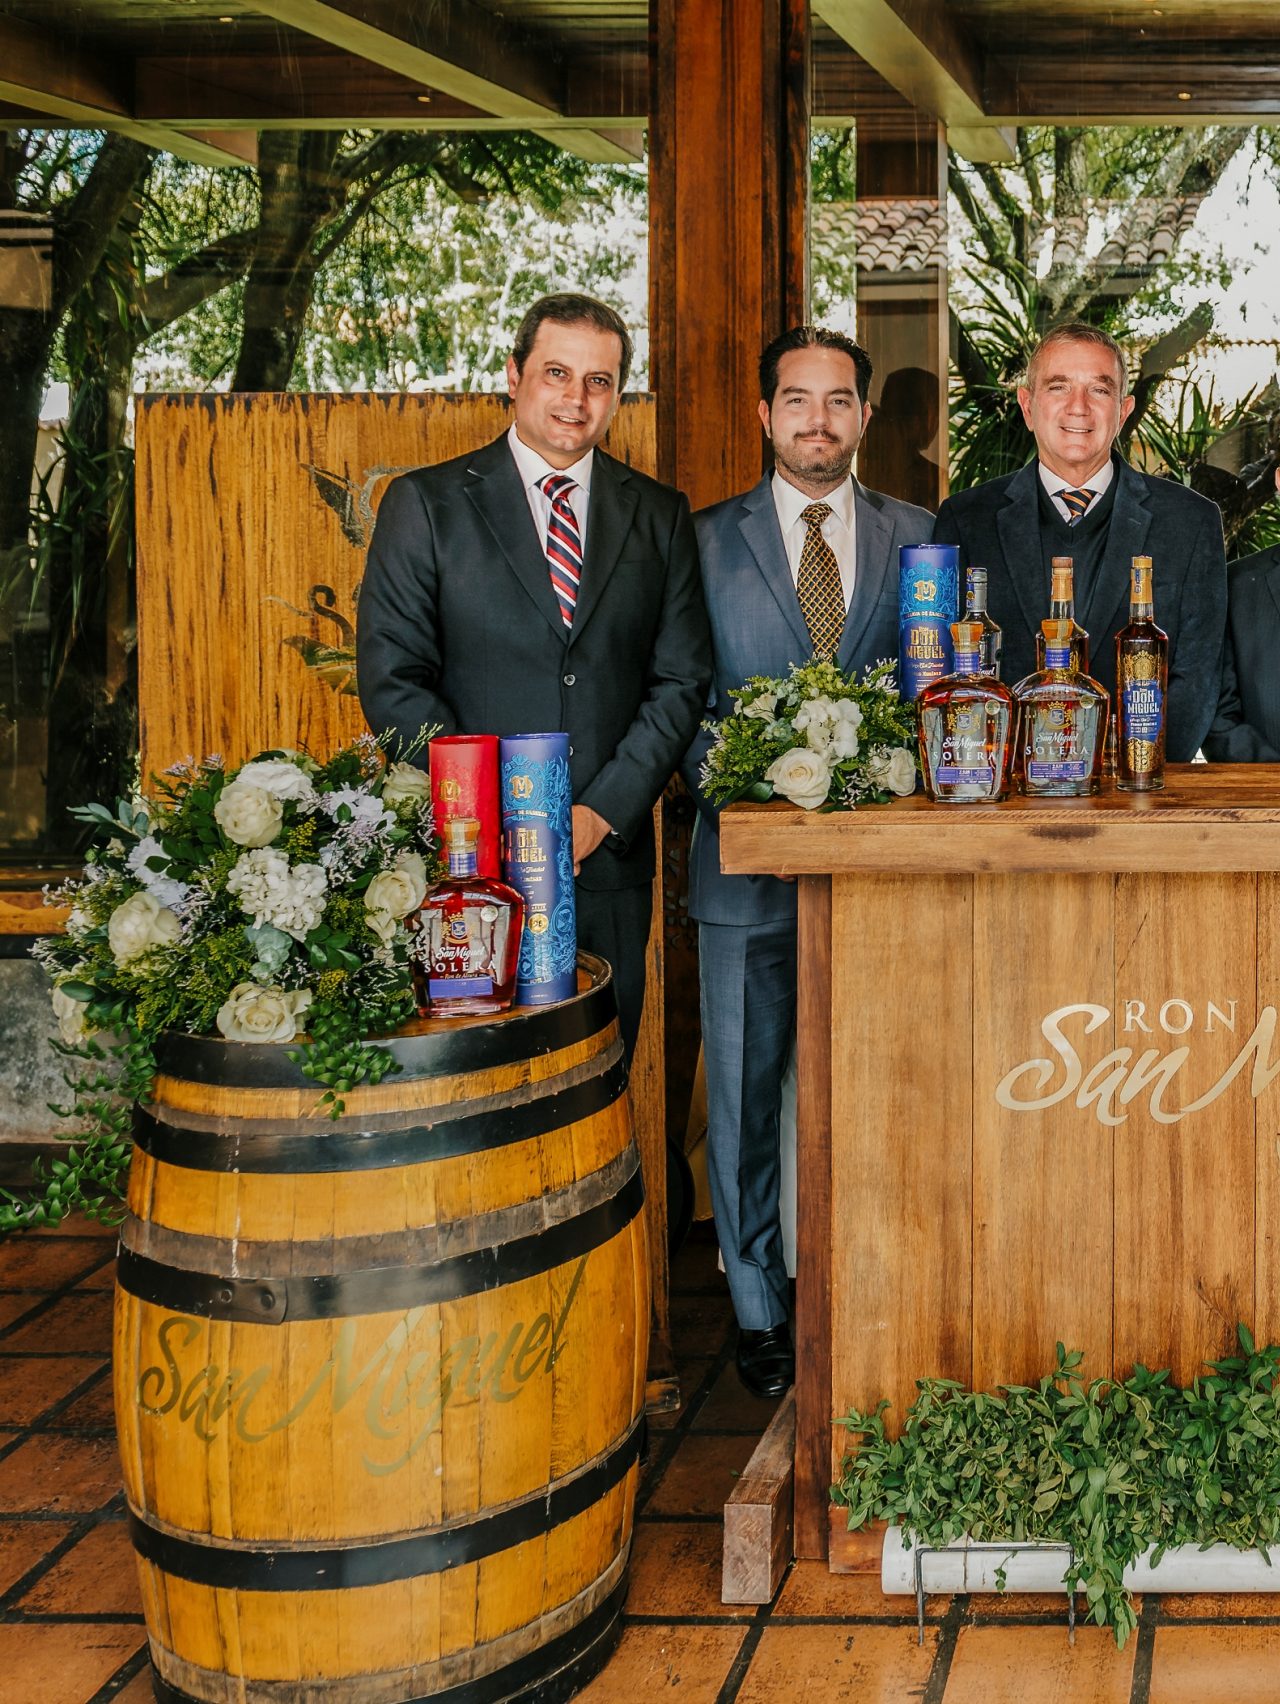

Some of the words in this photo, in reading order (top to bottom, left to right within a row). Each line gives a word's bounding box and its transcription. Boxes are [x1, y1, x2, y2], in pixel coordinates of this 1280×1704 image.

[911, 629, 938, 645] DON
[906, 646, 945, 659] MIGUEL
[1133, 690, 1154, 703] DON
[1128, 703, 1159, 714] MIGUEL
[933, 752, 996, 761] SOLERA
[1025, 746, 1088, 755] SOLERA
[436, 946, 457, 960] San
[424, 960, 496, 973] SOLERA
[1122, 1000, 1238, 1034] RON
[995, 1003, 1188, 1126] San
[138, 1316, 271, 1443] San
[266, 1256, 589, 1477] Miguel
